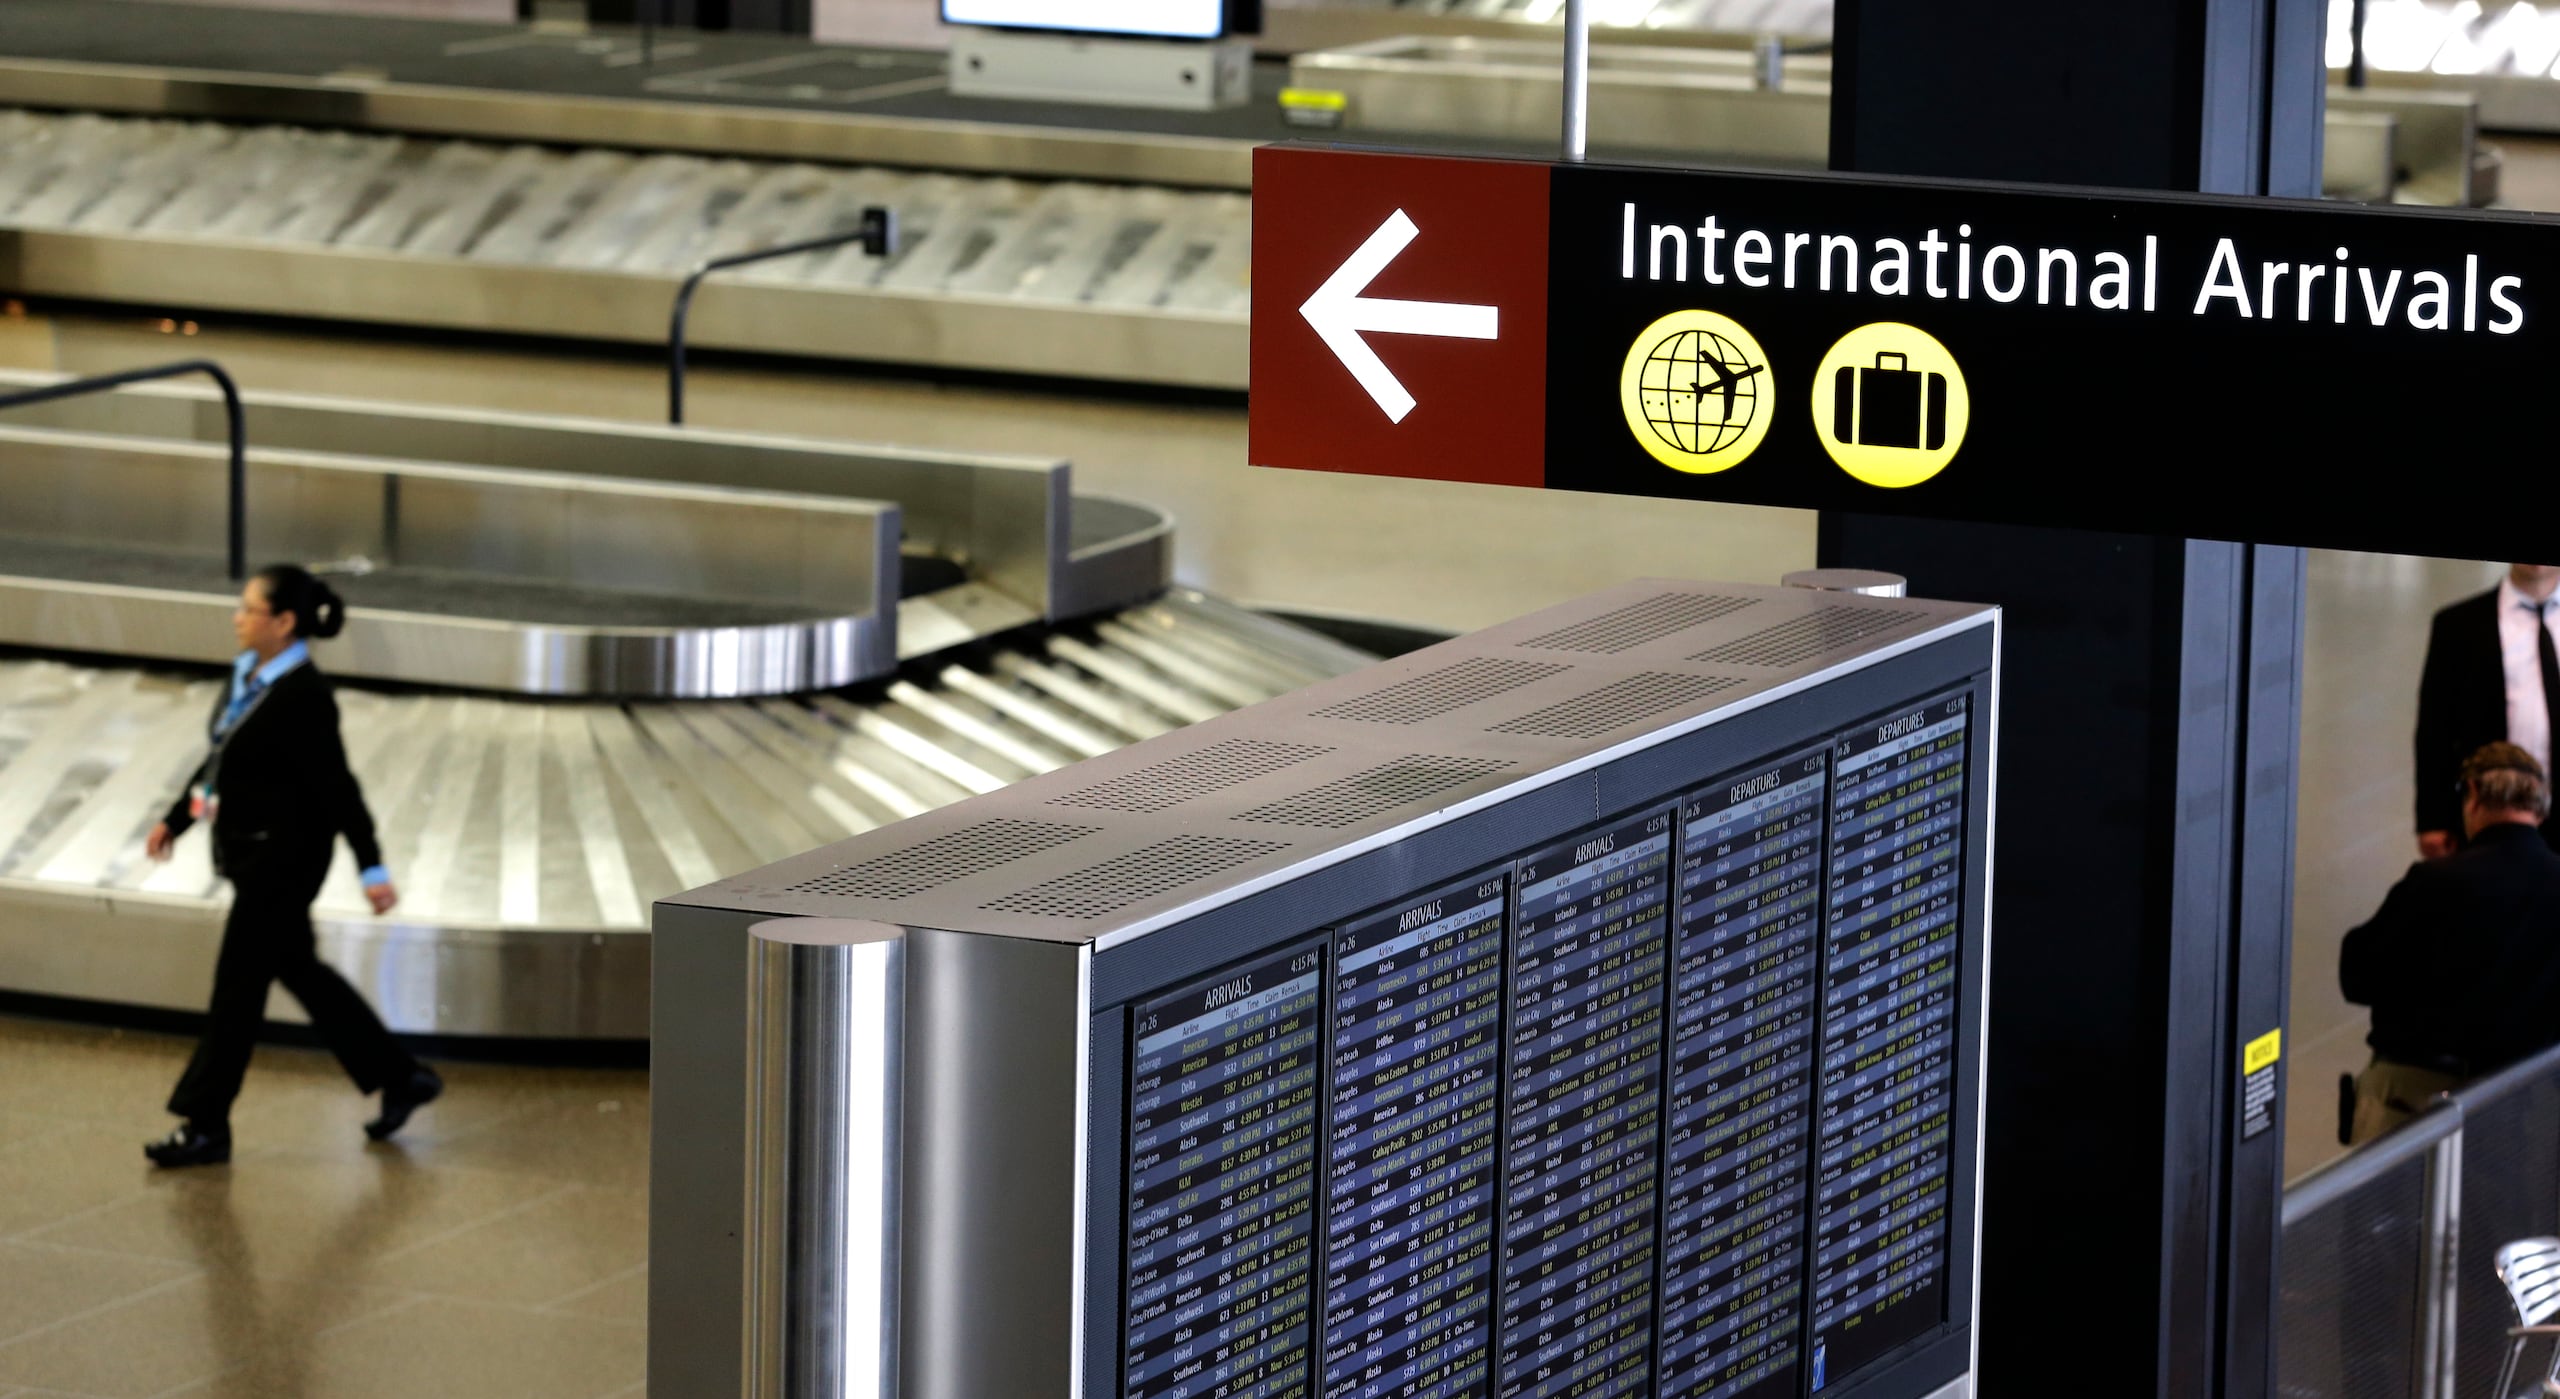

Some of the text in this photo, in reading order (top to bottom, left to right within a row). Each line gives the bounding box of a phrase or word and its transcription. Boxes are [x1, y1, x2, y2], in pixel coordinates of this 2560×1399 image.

[1623, 203, 2524, 334] International Arrivals
[1878, 710, 1924, 743] DEPARTURES
[1946, 699, 1957, 713] 4:15
[1692, 802, 1700, 816] 26
[1730, 769, 1780, 803] DEPARTURES
[1803, 757, 1815, 771] 4:15
[1793, 812, 1811, 825] On-Time
[1528, 866, 1535, 880] 26
[1574, 833, 1614, 864] ARRIVALS
[1646, 818, 1659, 832] 4:15
[1636, 876, 1655, 889] On-Time
[1347, 878, 1502, 950] 26 ARRIVALS 4:15 PM
[1378, 908, 1485, 957] Airline Flight Time Claim Remark
[1553, 940, 1577, 958] Southwest
[1148, 950, 1318, 1030] 26 ARRIVALS 4:15 PM
[1342, 960, 1394, 989] Vegas Alaska
[1552, 979, 1567, 993] Alaska
[1182, 1024, 1199, 1036] Airline
[1224, 1007, 1239, 1023] Flight
[1247, 999, 1259, 1010] Time
[1281, 981, 1299, 995] Remark
[1341, 997, 1393, 1026] Vegas Alaska
[1551, 1010, 1575, 1029] Southwest
[1136, 1076, 1161, 1092] nchorage
[1181, 1056, 1207, 1074] American
[1242, 1036, 1254, 1048] 4:45
[1280, 1017, 1298, 1034] Landed
[1137, 1056, 1161, 1072] nchorage
[1182, 1037, 1208, 1054] American
[1338, 1086, 1358, 1101] Angeles
[1374, 1073, 1389, 1085] China
[1389, 1065, 1408, 1079] Eastern
[1464, 1031, 1481, 1047] Landed
[1343, 1034, 1394, 1062] Beach JetBlue
[1549, 1048, 1571, 1064] American
[1135, 1118, 1150, 1132] tlanta
[1180, 1095, 1202, 1112] WestJet
[1241, 1074, 1252, 1086] 4:12
[1279, 1055, 1297, 1072] Landed
[1136, 1061, 1236, 1111] nchorage Delta 2632
[1337, 1069, 1483, 1138] Angeles American On-Time
[1548, 1087, 1562, 1099] China
[1134, 1098, 1290, 1171] ellingham Alaska 2481 4:39 Now
[1135, 1135, 1157, 1151] altimore
[1180, 1111, 1208, 1132] Southwest
[1132, 1198, 1144, 1210] oise
[1178, 1175, 1191, 1189] KLM
[1277, 1135, 1289, 1147] Now
[1179, 1153, 1203, 1171] Emirates
[1336, 1136, 1406, 1175] Angeles Cathay Pacific
[1131, 1226, 1168, 1248] hicago-O'Hare
[1177, 1214, 1192, 1228] Delta
[1238, 1187, 1249, 1200] 4:55
[1275, 1173, 1288, 1184] Now
[1132, 1206, 1169, 1227] hicago-O'Hare
[1178, 1193, 1190, 1209] Gulf
[1188, 1193, 1198, 1204] Air
[1335, 1197, 1354, 1213] Angeles
[1371, 1179, 1388, 1196] United
[1370, 1219, 1383, 1233] Delta
[1459, 1175, 1476, 1192] Landed
[1370, 1195, 1396, 1215] Southwest
[1177, 1231, 1199, 1248] Frontier
[1368, 1211, 1475, 1270] Alaska Landed
[1369, 1194, 1478, 1252] Sun Country On-Time
[1131, 1269, 1157, 1287] allas-Love
[1176, 1246, 1205, 1267] Southwest
[1237, 1225, 1248, 1238] 4:10
[1274, 1211, 1286, 1222] Now
[1130, 1301, 1166, 1326] allas/FtWorth
[1175, 1286, 1201, 1305] American
[1273, 1248, 1285, 1259] Now
[1287, 1239, 1298, 1252] 4:37
[1131, 1282, 1166, 1307] allas/FtWorth
[1175, 1270, 1193, 1286] Alaska
[1129, 1351, 1144, 1365] enver
[1174, 1327, 1192, 1344] Alaska
[1272, 1286, 1284, 1297] Now
[1175, 1303, 1203, 1325] Southwest
